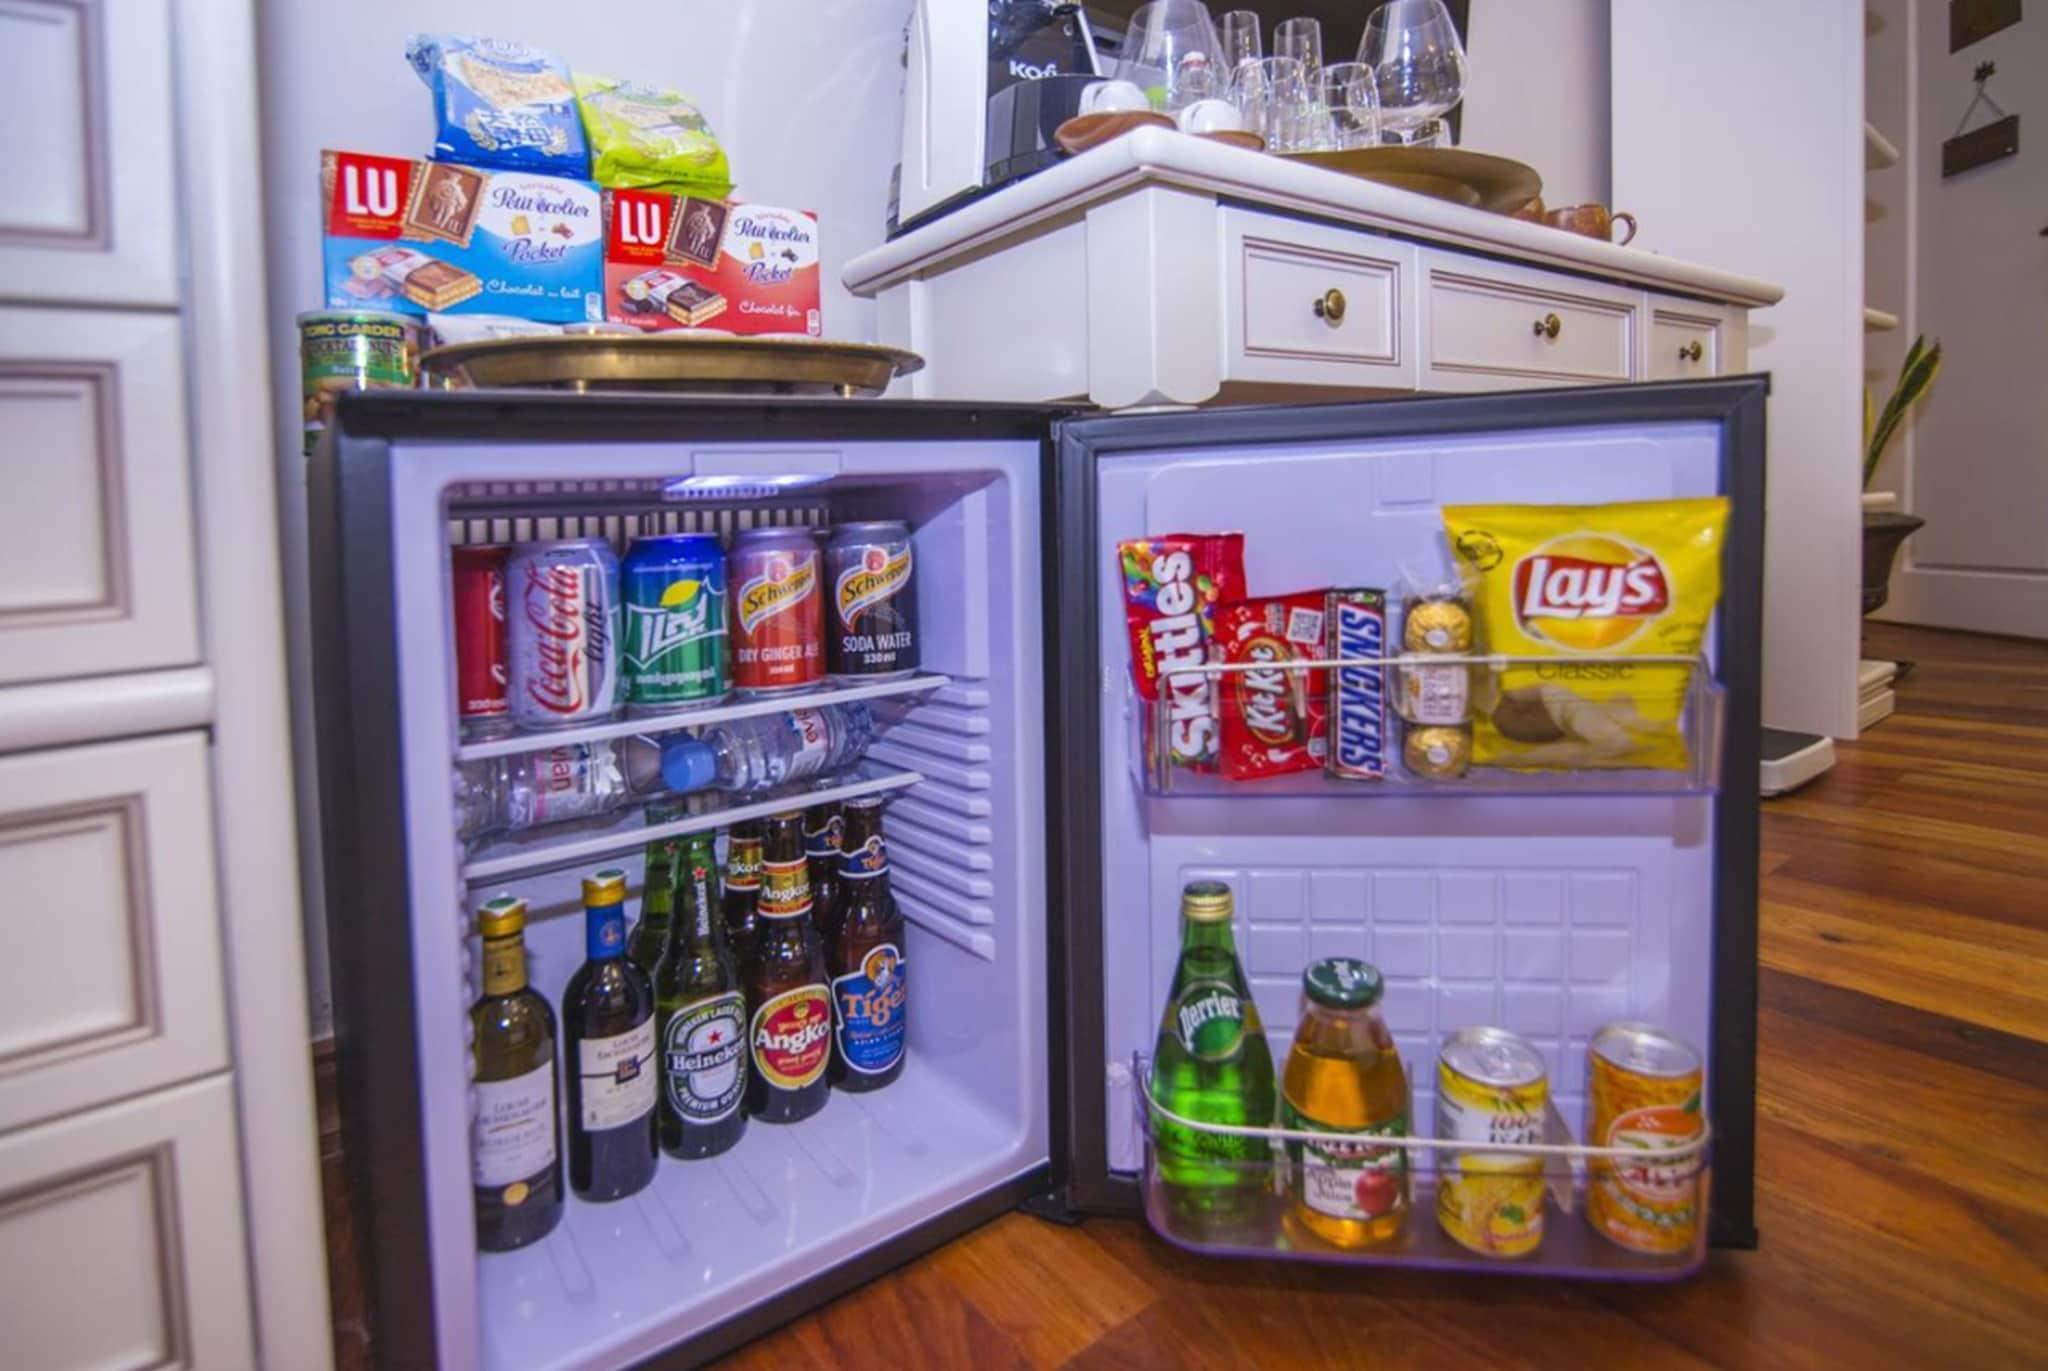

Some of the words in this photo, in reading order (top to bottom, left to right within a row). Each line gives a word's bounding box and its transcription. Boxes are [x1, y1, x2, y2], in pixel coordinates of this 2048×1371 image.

[344, 164, 398, 217] LU
[492, 186, 534, 211] Petit
[620, 200, 661, 245] LU
[734, 217, 767, 239] Petit
[503, 238, 569, 263] Pocket
[743, 260, 793, 284] Pocket
[338, 323, 401, 337] GARDEN
[1523, 557, 1659, 617] Lay's
[523, 560, 583, 714] Coca-Cola
[584, 601, 611, 663] light
[842, 634, 875, 653] SODA
[876, 631, 912, 651] WATER
[739, 647, 759, 664] DRY
[761, 645, 802, 663] GINGER
[795, 708, 818, 744] evi
[550, 746, 571, 793] vian
[761, 883, 811, 902] Angkor
[841, 984, 907, 1027] Tige
[1179, 989, 1241, 1053] Perrier
[755, 1021, 831, 1054] Angko
